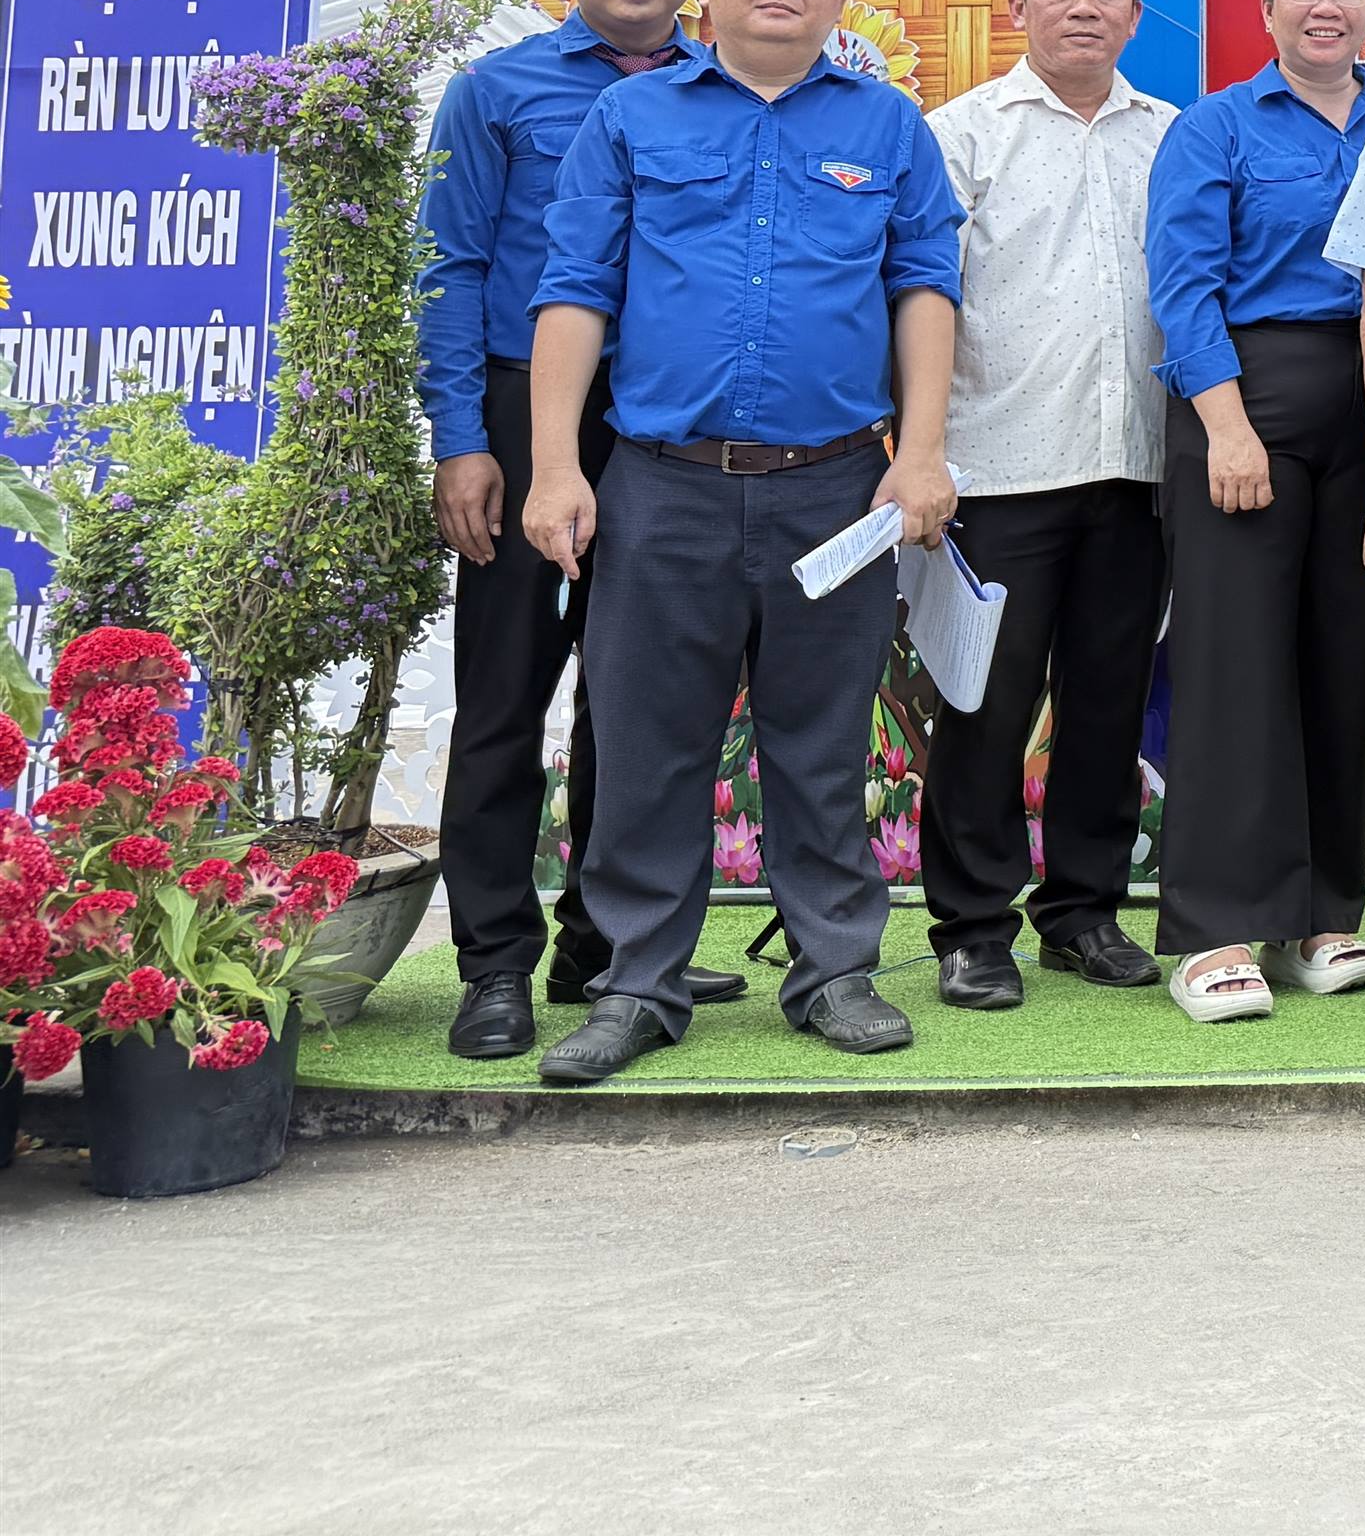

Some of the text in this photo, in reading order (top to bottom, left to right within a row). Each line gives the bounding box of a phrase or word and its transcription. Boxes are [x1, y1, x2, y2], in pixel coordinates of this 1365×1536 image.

[37, 39, 246, 148] RÈN LUY
[28, 173, 241, 268] XUNG KÍCH
[96, 309, 256, 421] NGUYỆN
